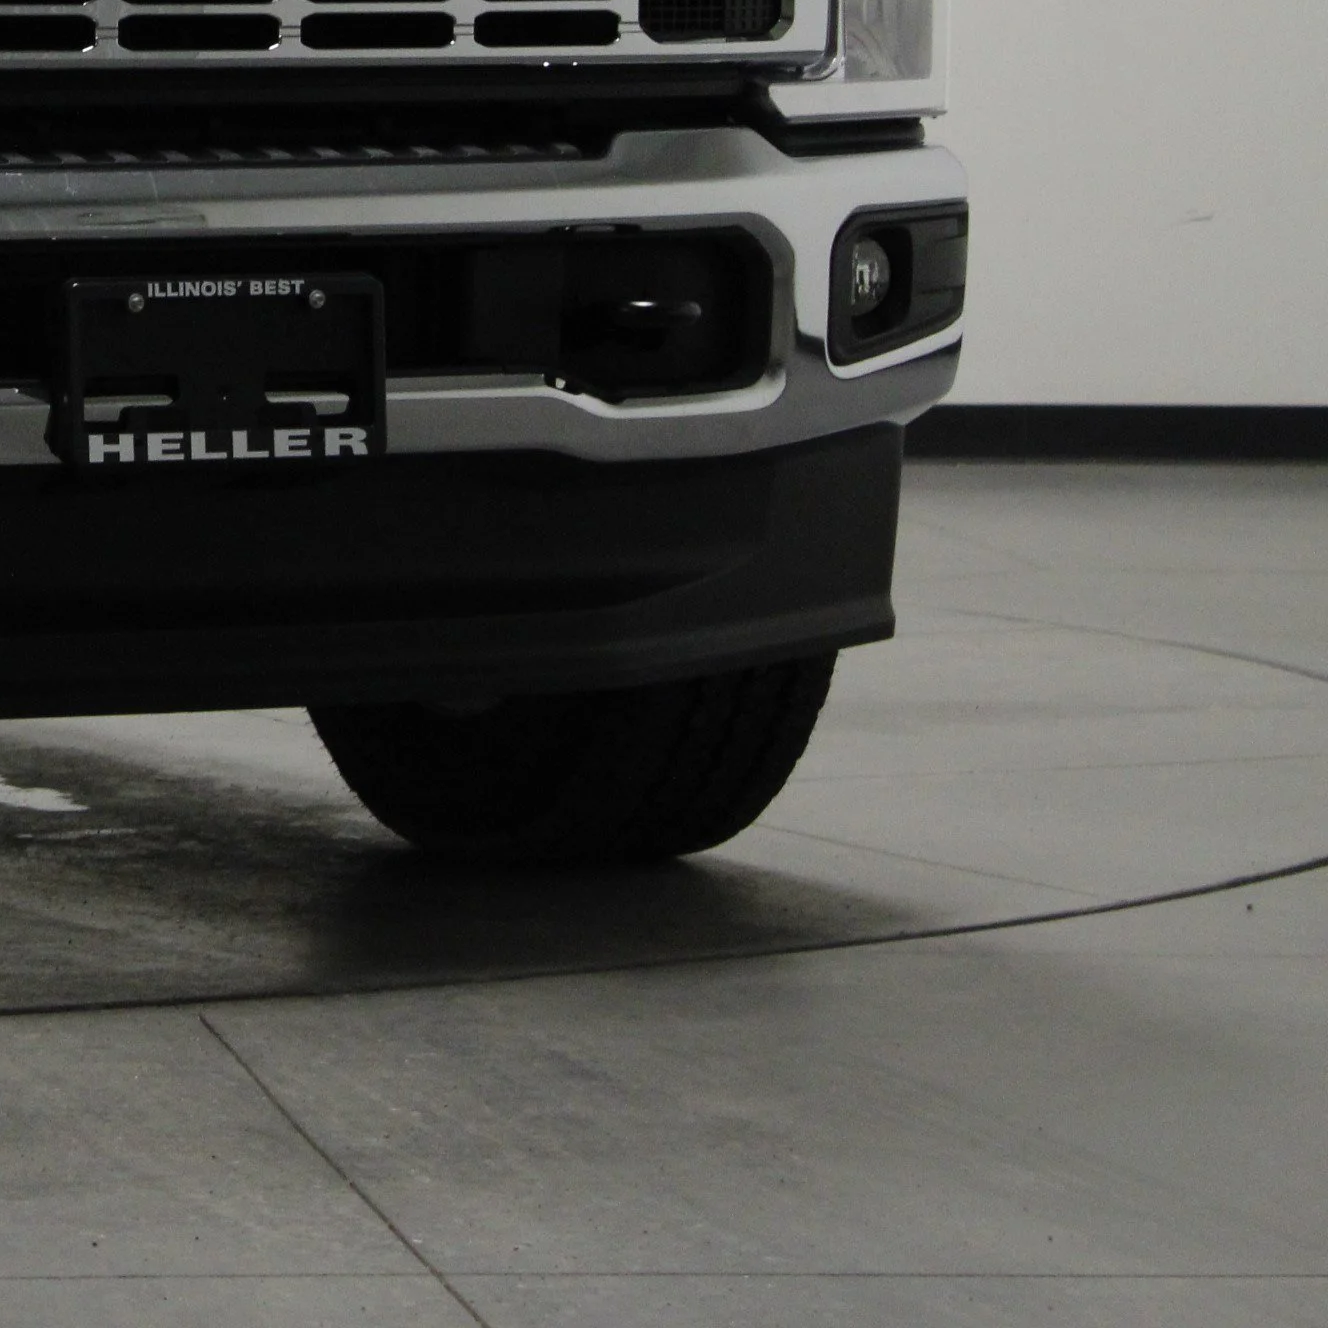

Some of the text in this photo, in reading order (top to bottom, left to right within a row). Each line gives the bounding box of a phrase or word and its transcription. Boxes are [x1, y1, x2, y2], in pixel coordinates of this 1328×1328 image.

[147, 279, 306, 298] ILLINOIS' BEST
[88, 427, 369, 463] HELLER
